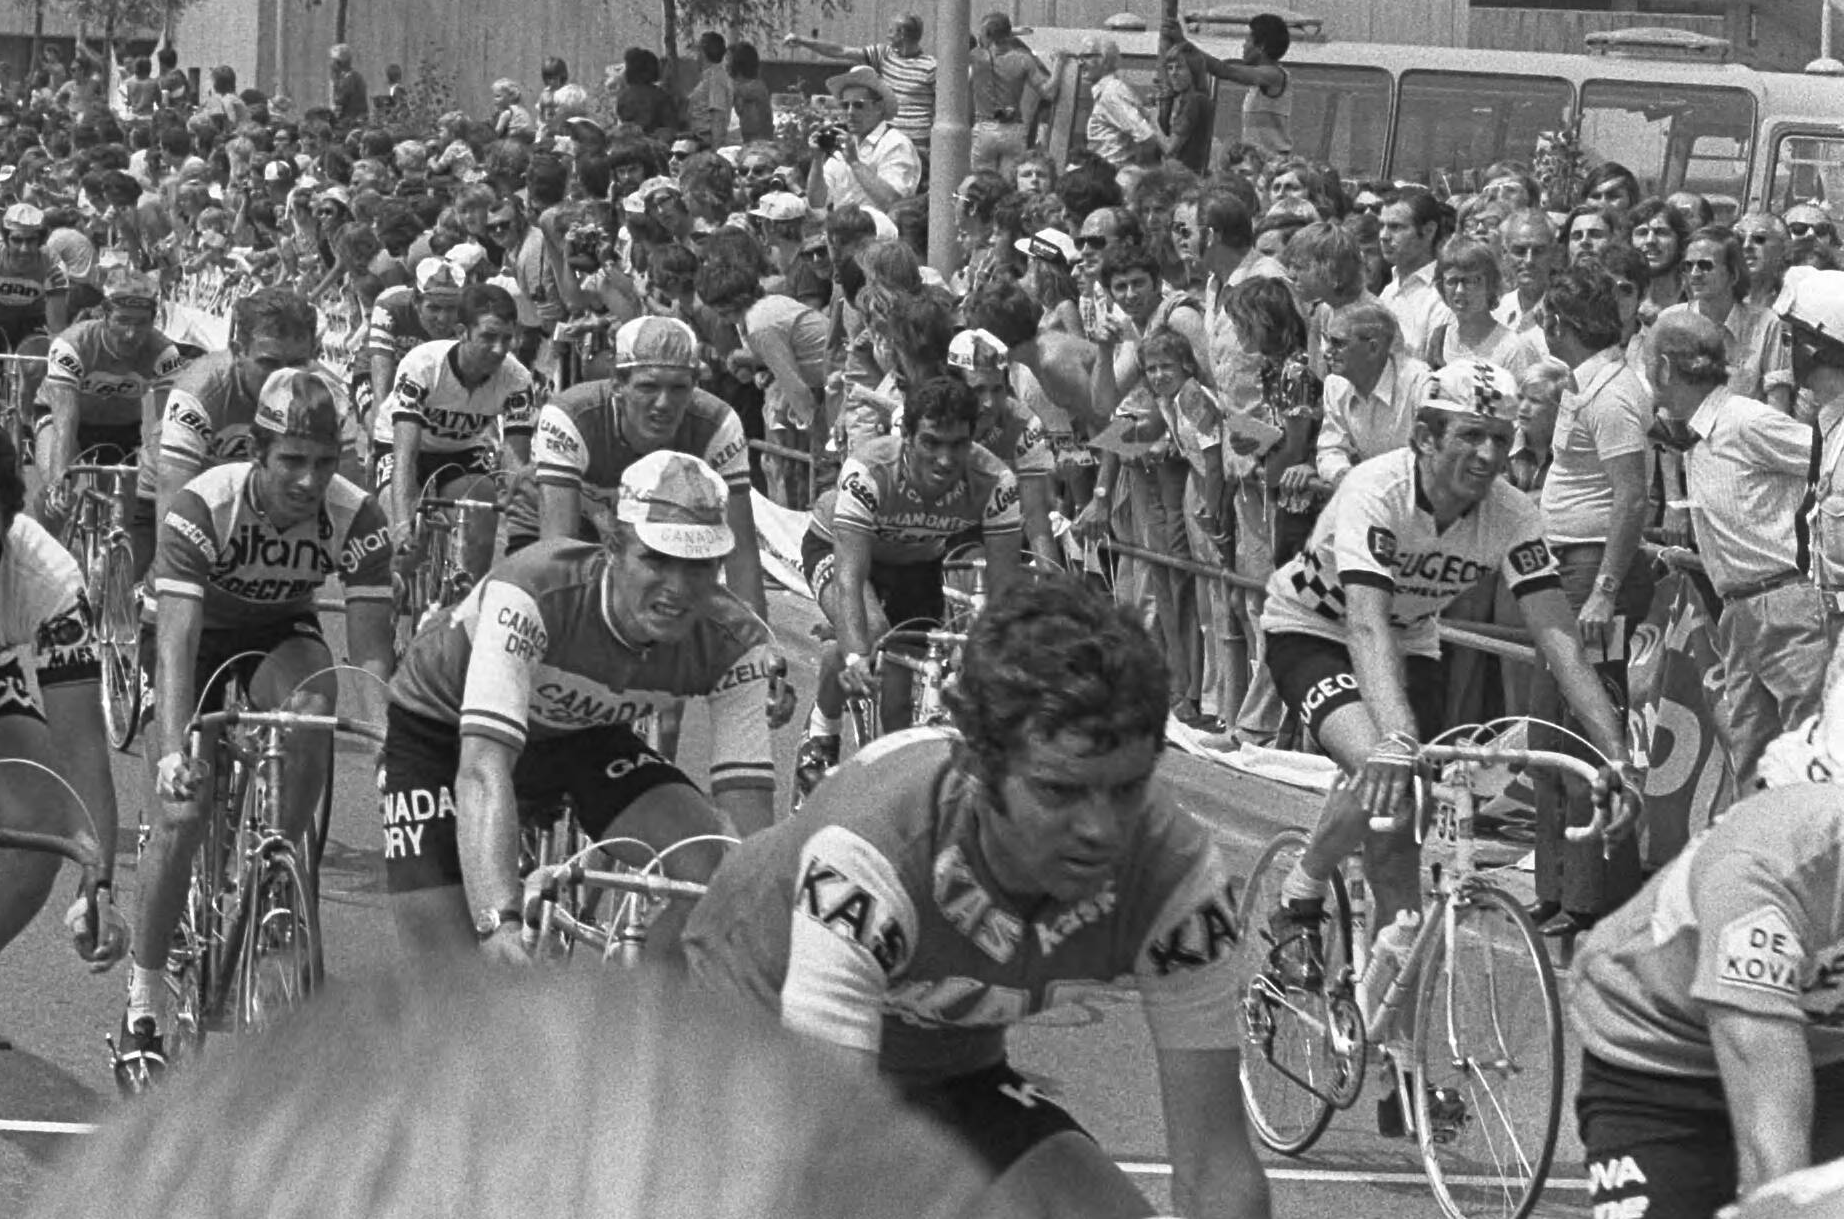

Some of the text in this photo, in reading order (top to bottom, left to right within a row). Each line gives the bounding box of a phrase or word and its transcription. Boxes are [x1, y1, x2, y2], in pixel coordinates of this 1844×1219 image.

[1517, 546, 1549, 571] BP
[48, 646, 95, 667] MAES
[797, 855, 906, 975] KAS
[1148, 880, 1238, 975] KA
[1751, 928, 1787, 955] DE
